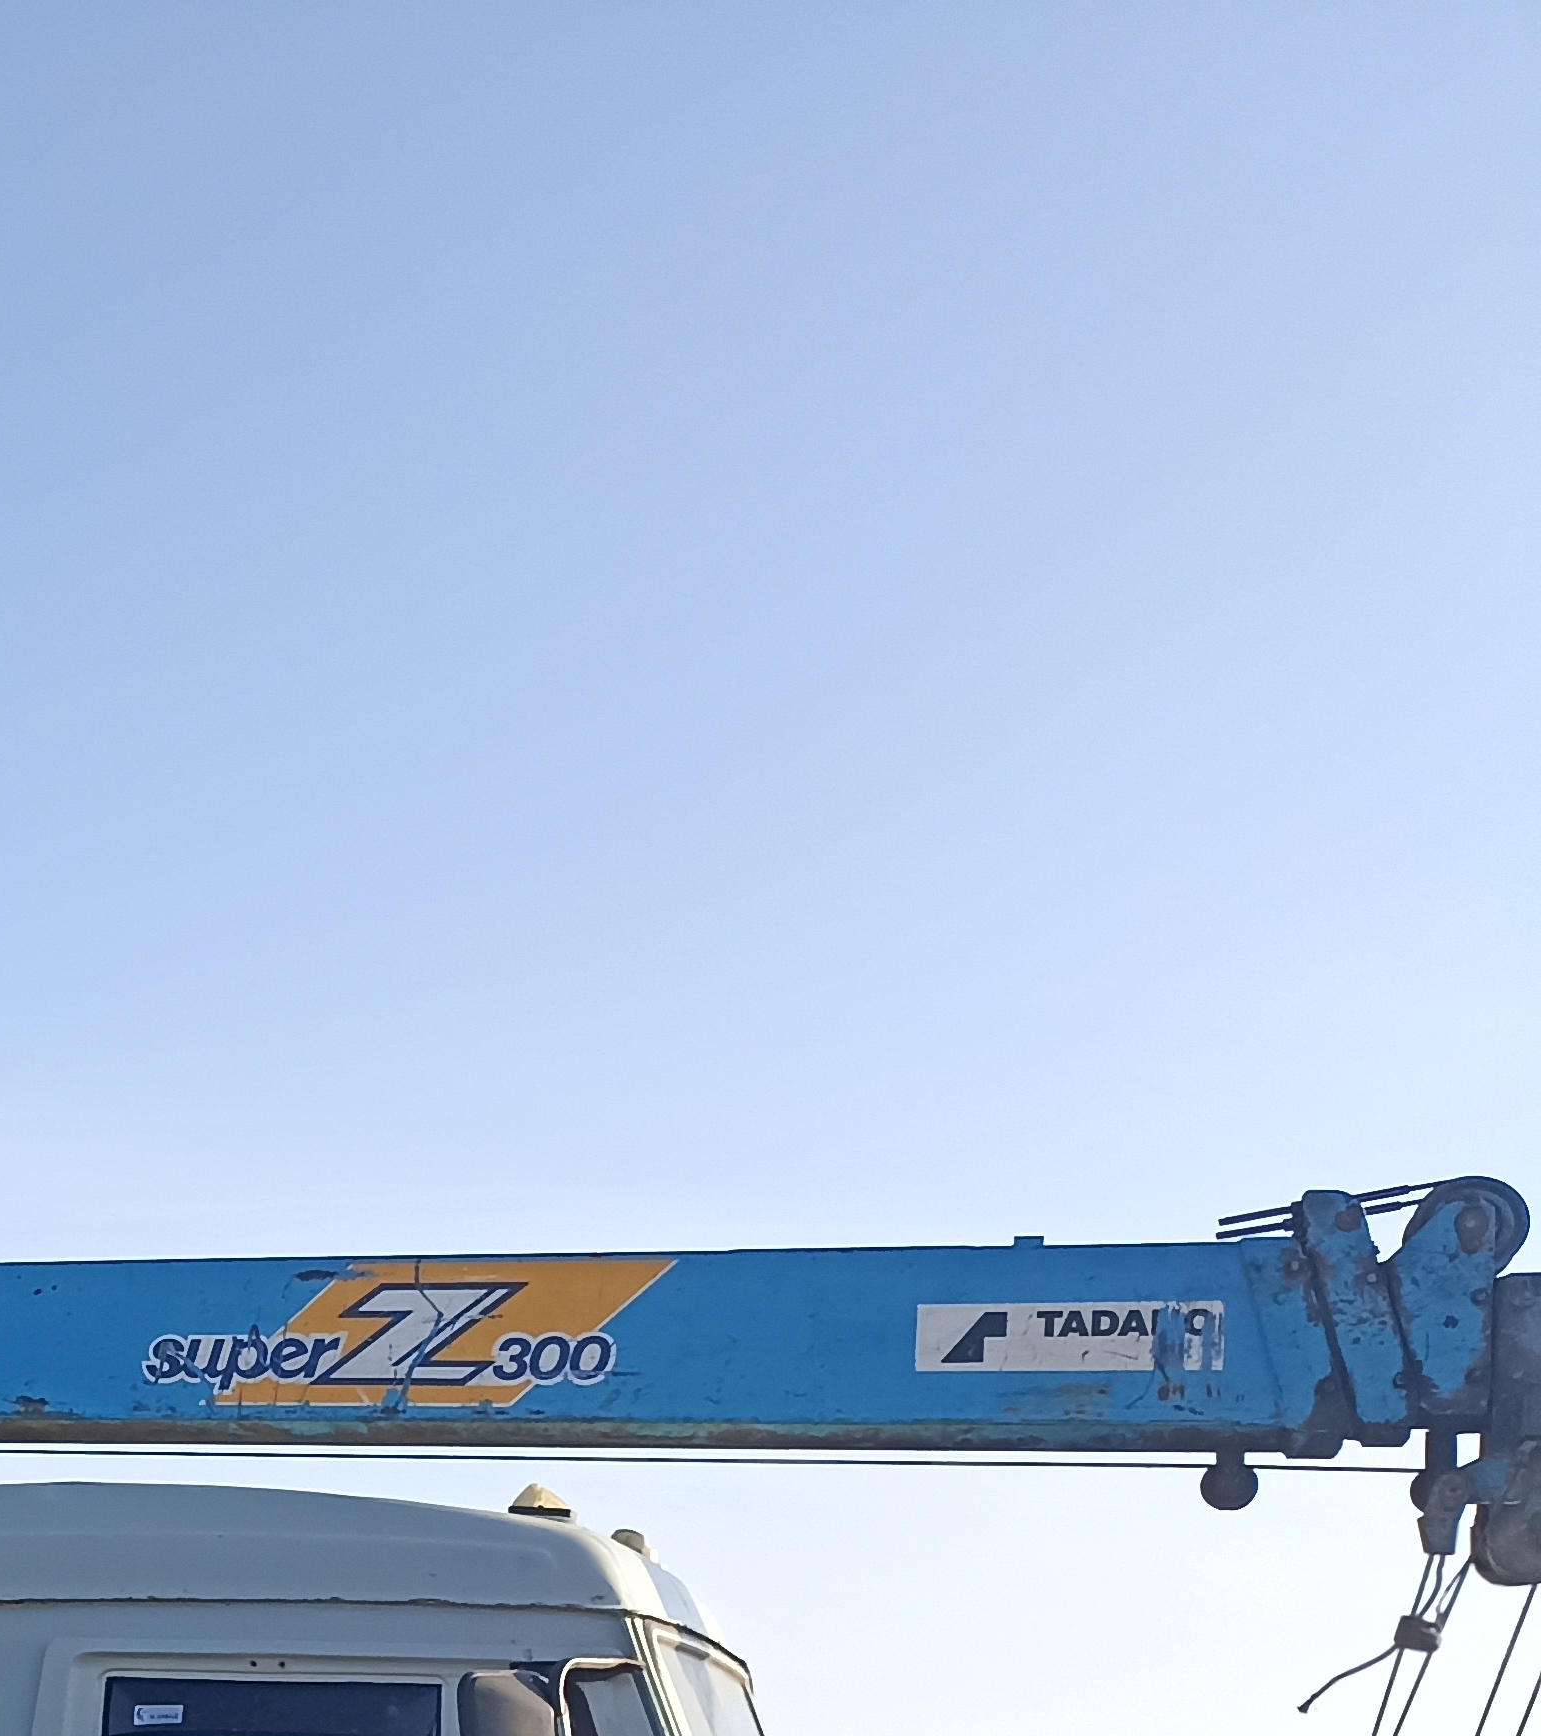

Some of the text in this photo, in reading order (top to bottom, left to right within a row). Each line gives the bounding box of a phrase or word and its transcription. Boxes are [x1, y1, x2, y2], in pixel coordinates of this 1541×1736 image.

[1036, 1308, 1213, 1337] TADAO
[146, 1333, 341, 1390] super
[491, 1334, 613, 1383] 300
